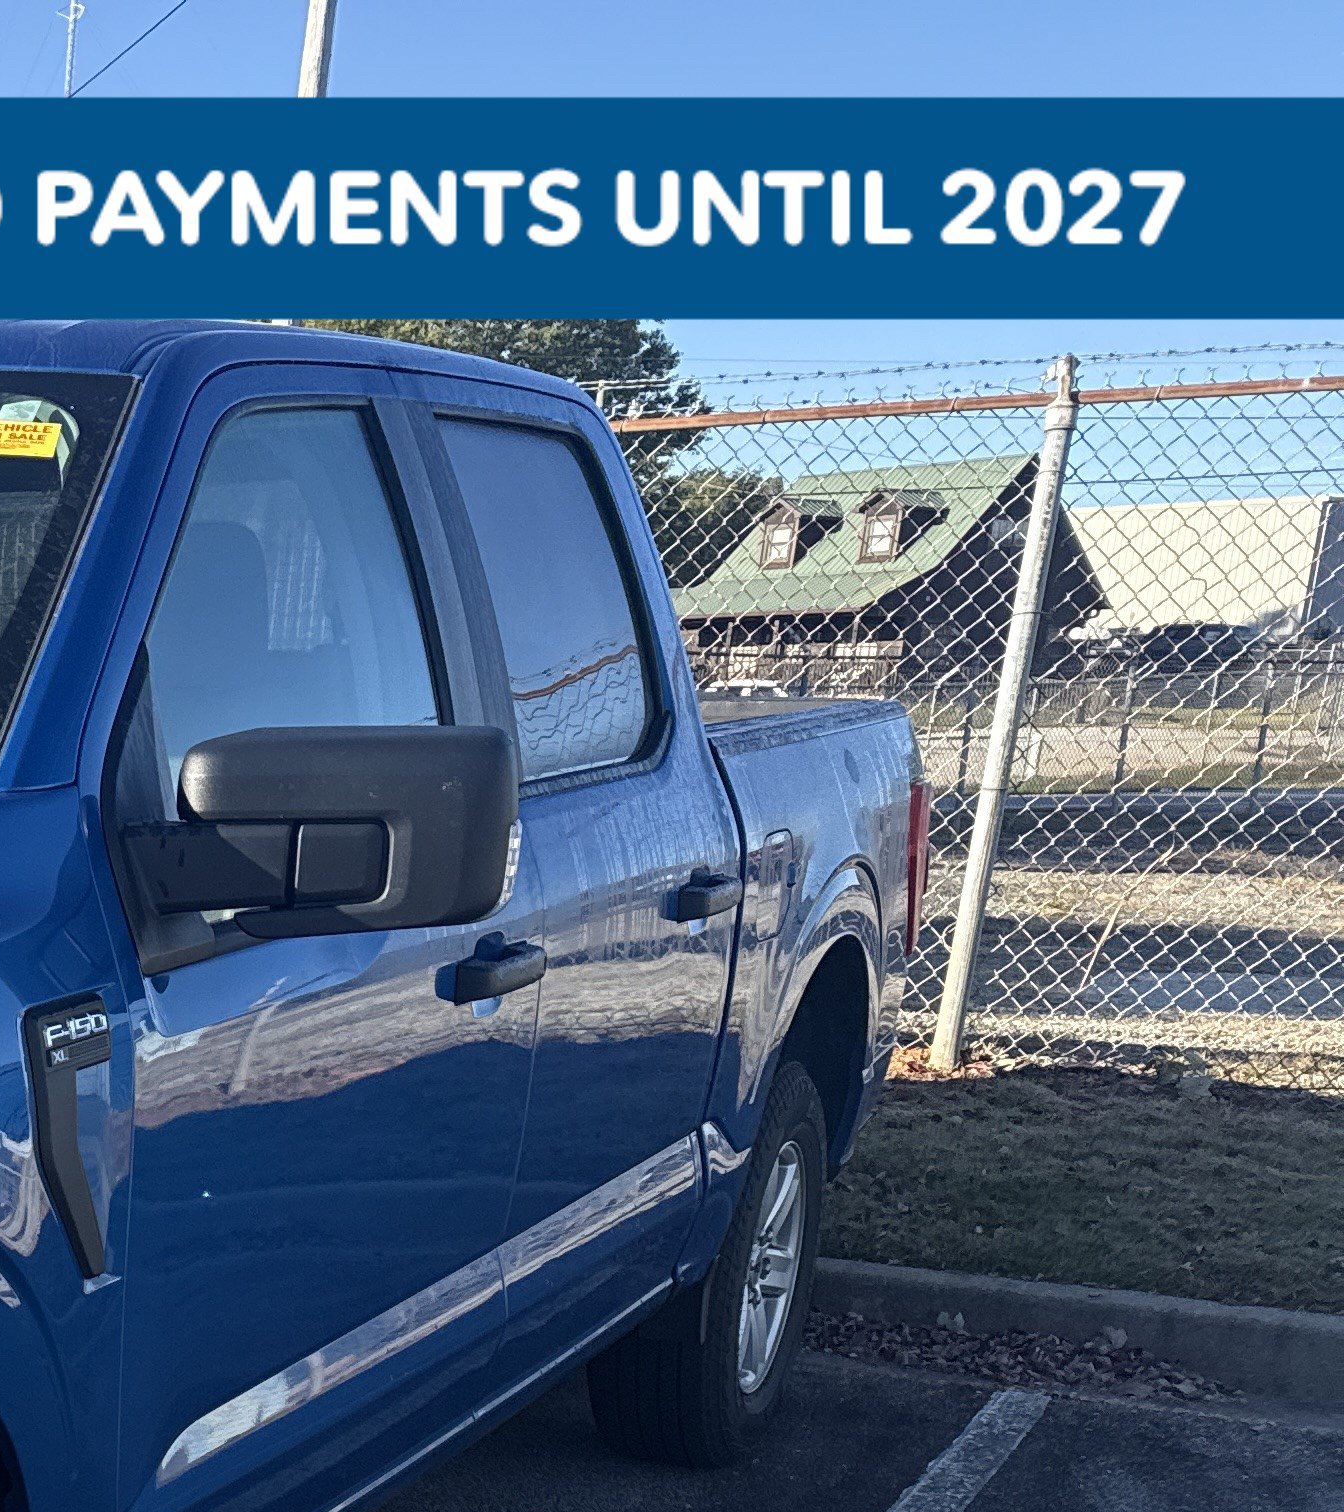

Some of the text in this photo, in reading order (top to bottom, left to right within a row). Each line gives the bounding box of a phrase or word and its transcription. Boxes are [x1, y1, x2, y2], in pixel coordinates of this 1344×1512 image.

[8, 432, 48, 441] SALE
[43, 1012, 108, 1047] F-150
[52, 1049, 69, 1064] XL
